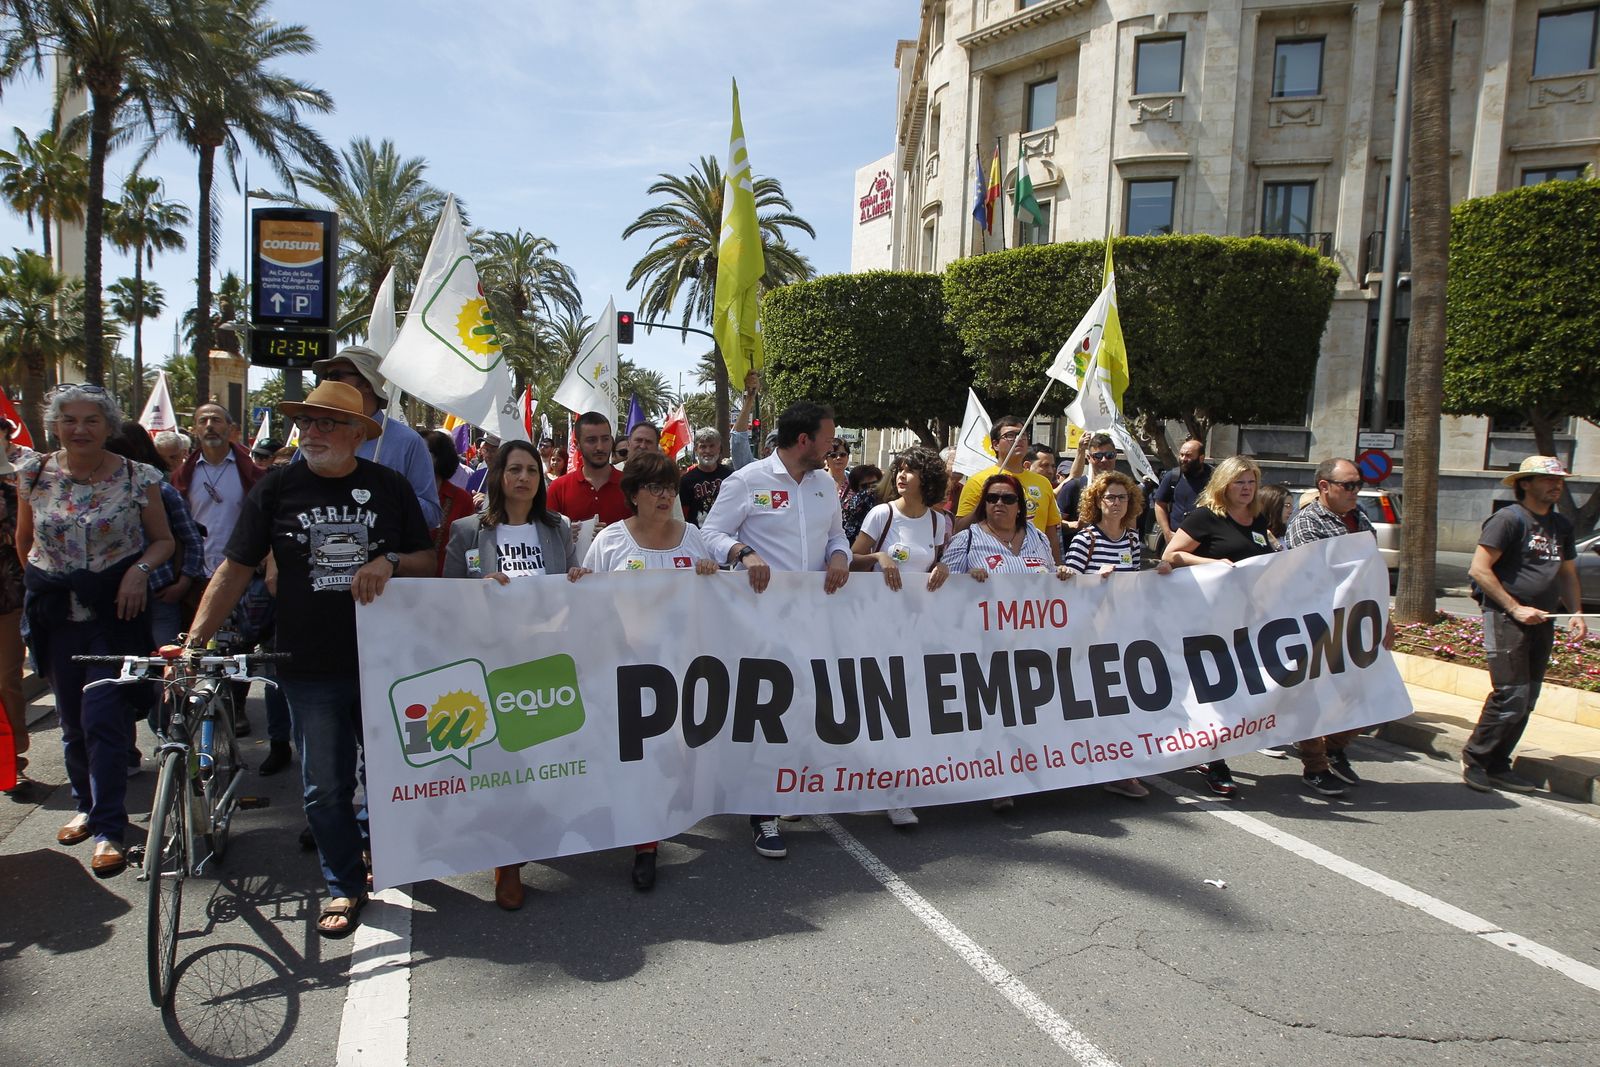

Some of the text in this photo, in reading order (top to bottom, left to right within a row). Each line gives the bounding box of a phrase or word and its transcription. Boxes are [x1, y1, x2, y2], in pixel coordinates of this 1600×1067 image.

[263, 240, 320, 250] consum
[296, 296, 308, 311] P
[270, 340, 319, 356] 12:34
[297, 505, 378, 529] BERLIN
[979, 599, 1067, 630] 1 MAYO
[616, 599, 1383, 763] POR UN EMPLEO DIGNO
[776, 714, 1276, 793] Día Internacional de la Clase Trabajadora
[391, 760, 587, 802] ALMERÍA PARA LA GENTE
